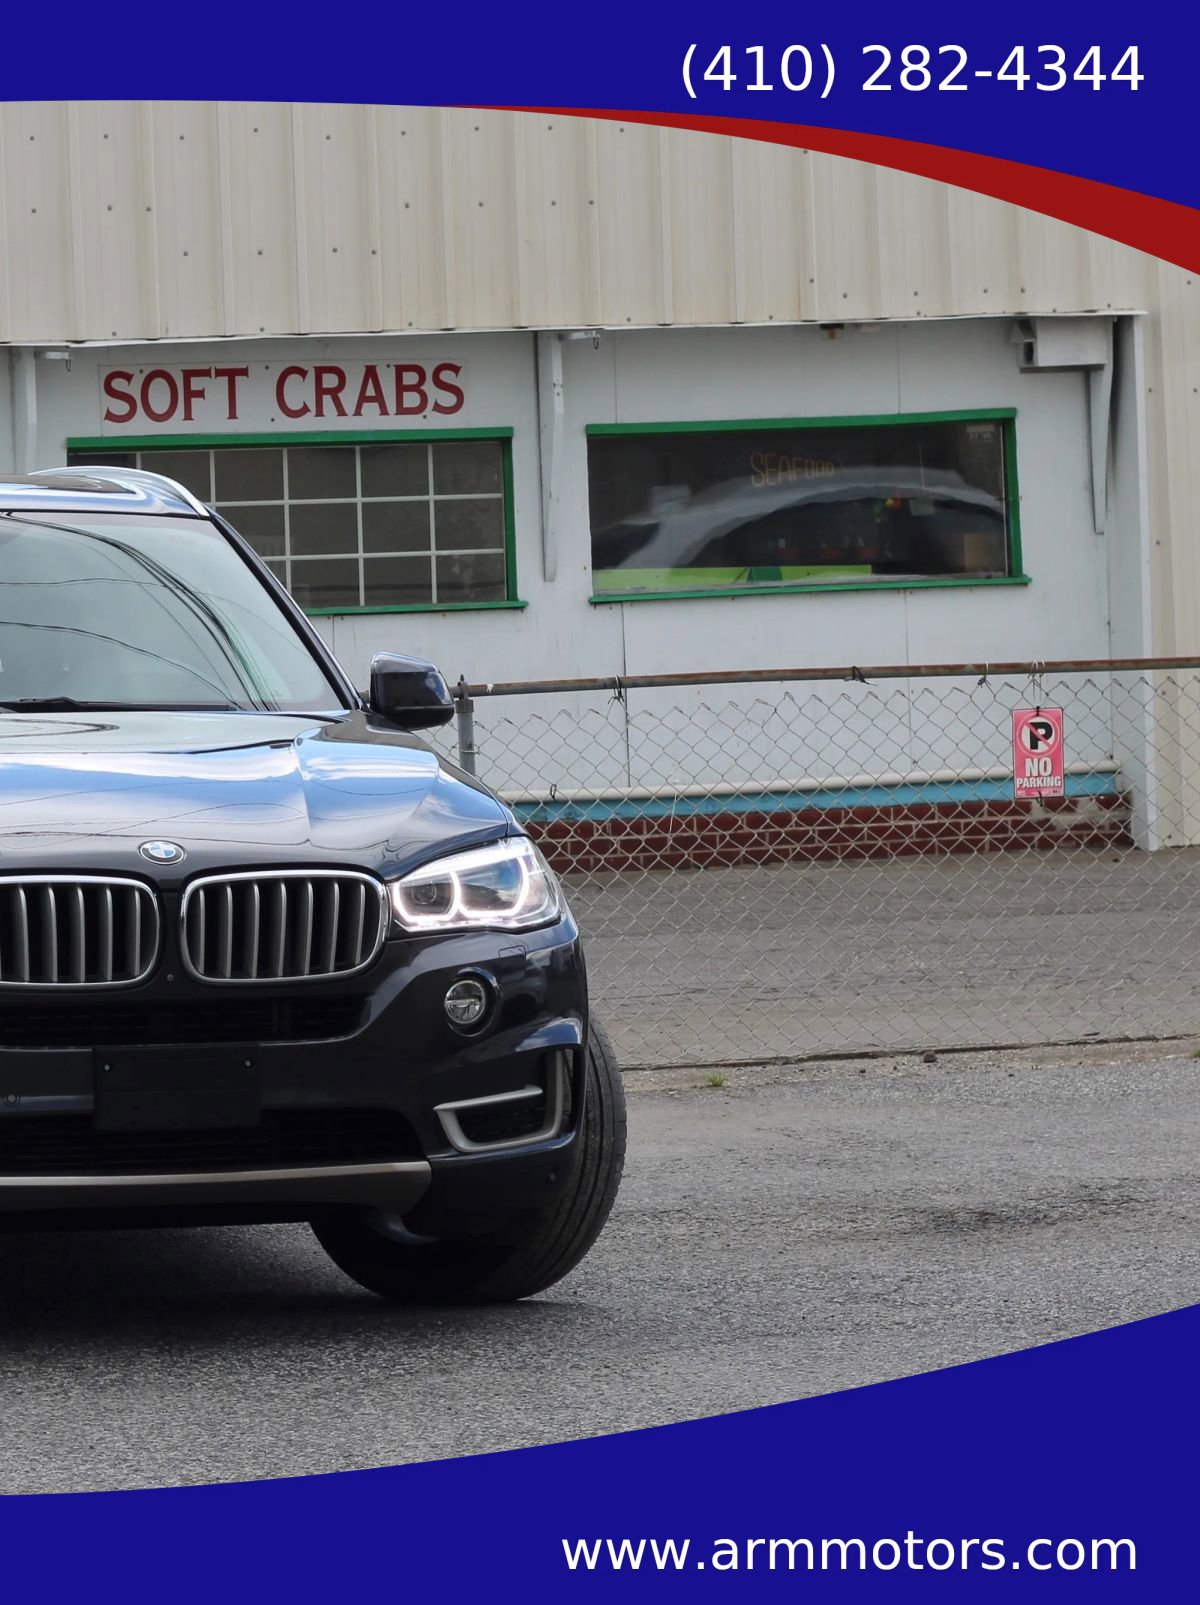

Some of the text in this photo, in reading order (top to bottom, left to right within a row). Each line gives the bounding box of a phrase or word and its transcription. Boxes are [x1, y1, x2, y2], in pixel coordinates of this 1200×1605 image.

[103, 362, 465, 423] SOFT CRABS
[750, 451, 835, 488] SEAFOOD
[1025, 757, 1053, 777] NO
[1016, 775, 1062, 788] PARKING
